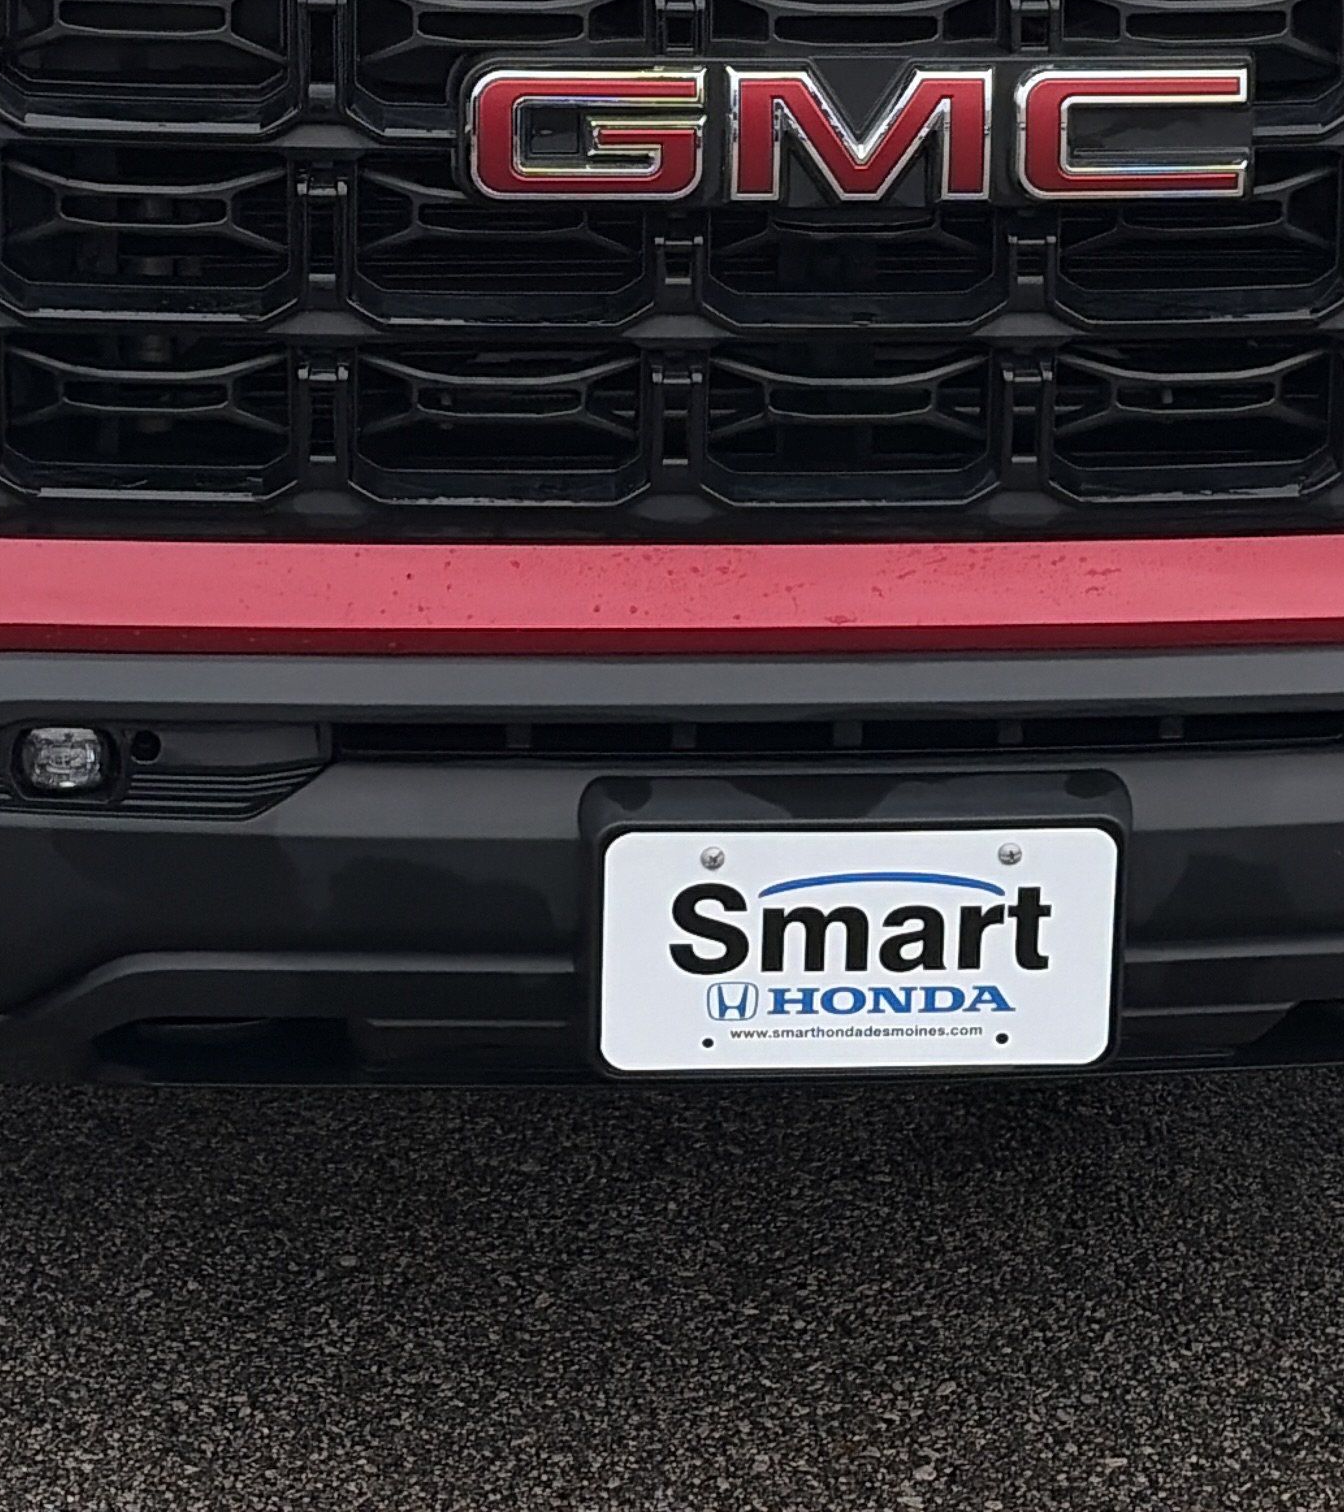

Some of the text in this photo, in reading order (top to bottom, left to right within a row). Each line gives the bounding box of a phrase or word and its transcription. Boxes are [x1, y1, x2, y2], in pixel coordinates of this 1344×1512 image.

[468, 66, 1250, 201] GMC
[668, 882, 1052, 975] Smart
[766, 985, 1017, 1015] HONDA
[729, 1023, 984, 1040] www.smarthondadesmoines.com
